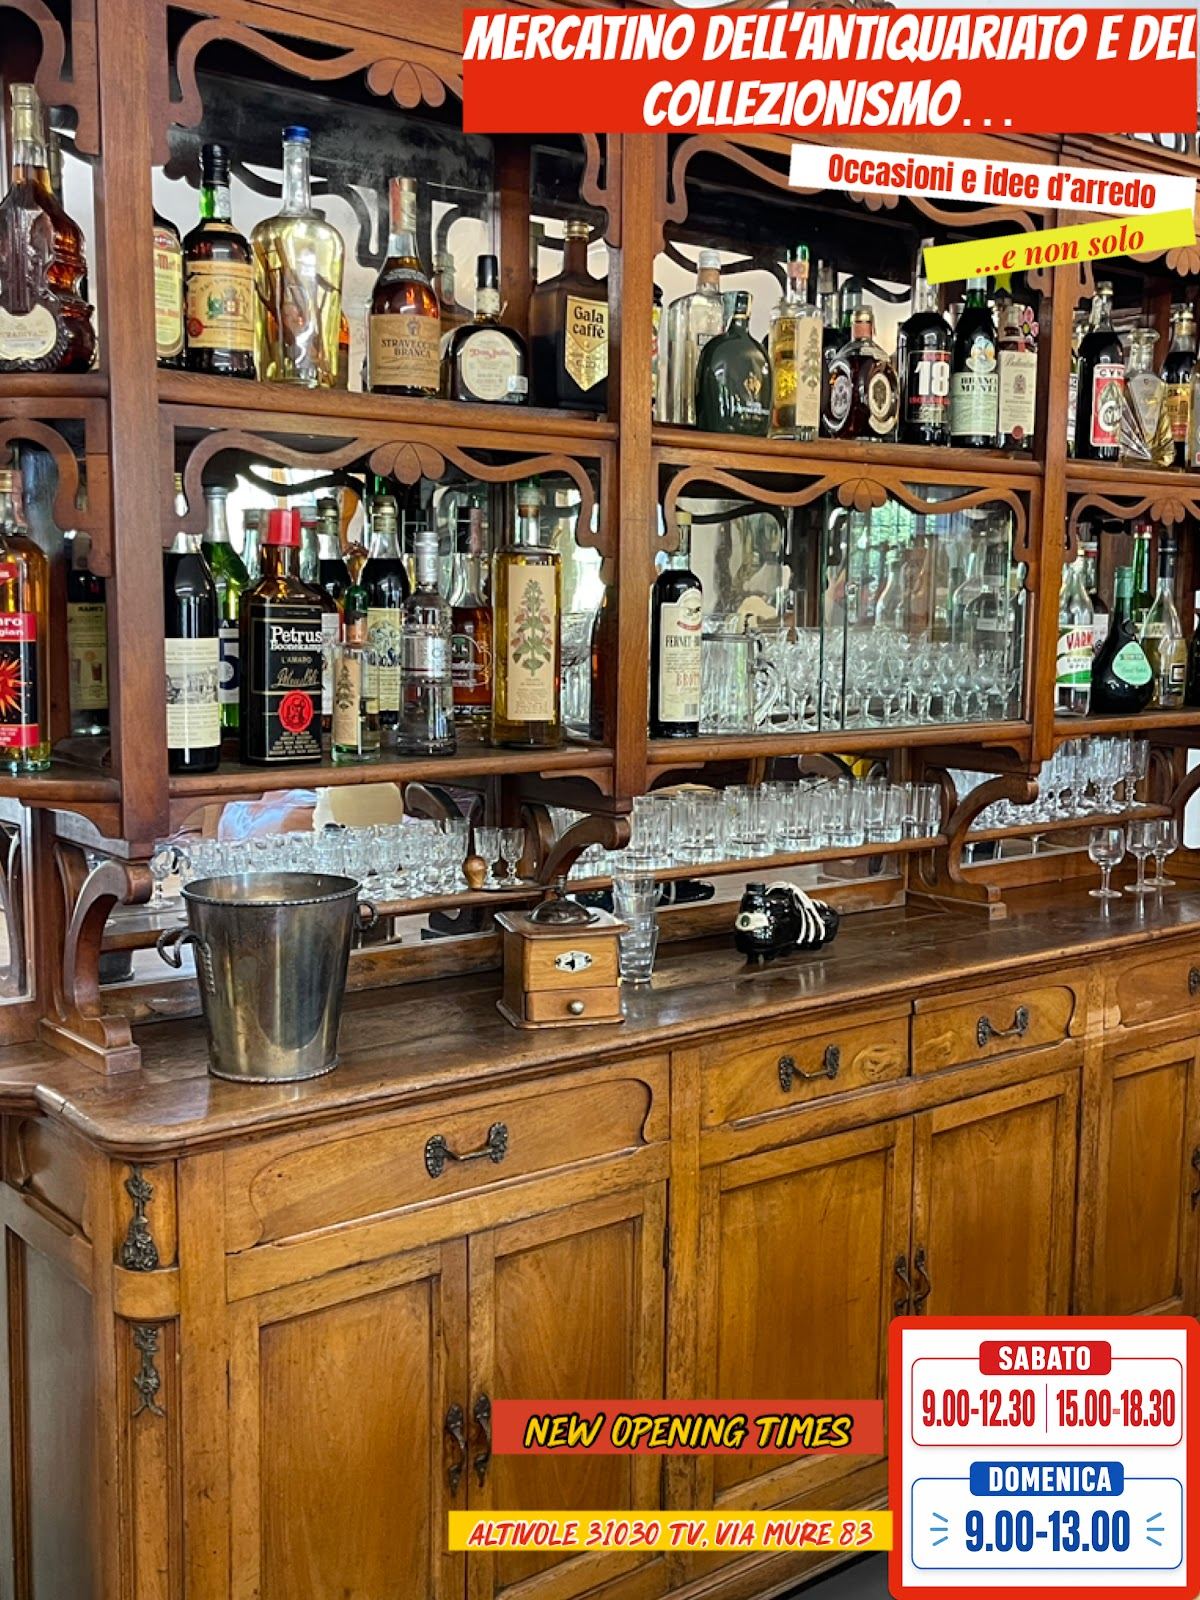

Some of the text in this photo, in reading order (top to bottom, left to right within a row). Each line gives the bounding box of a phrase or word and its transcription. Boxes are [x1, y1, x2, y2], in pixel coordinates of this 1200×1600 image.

[574, 306, 604, 324] Gala
[914, 361, 950, 396] 18
[270, 625, 323, 643] Petrus
